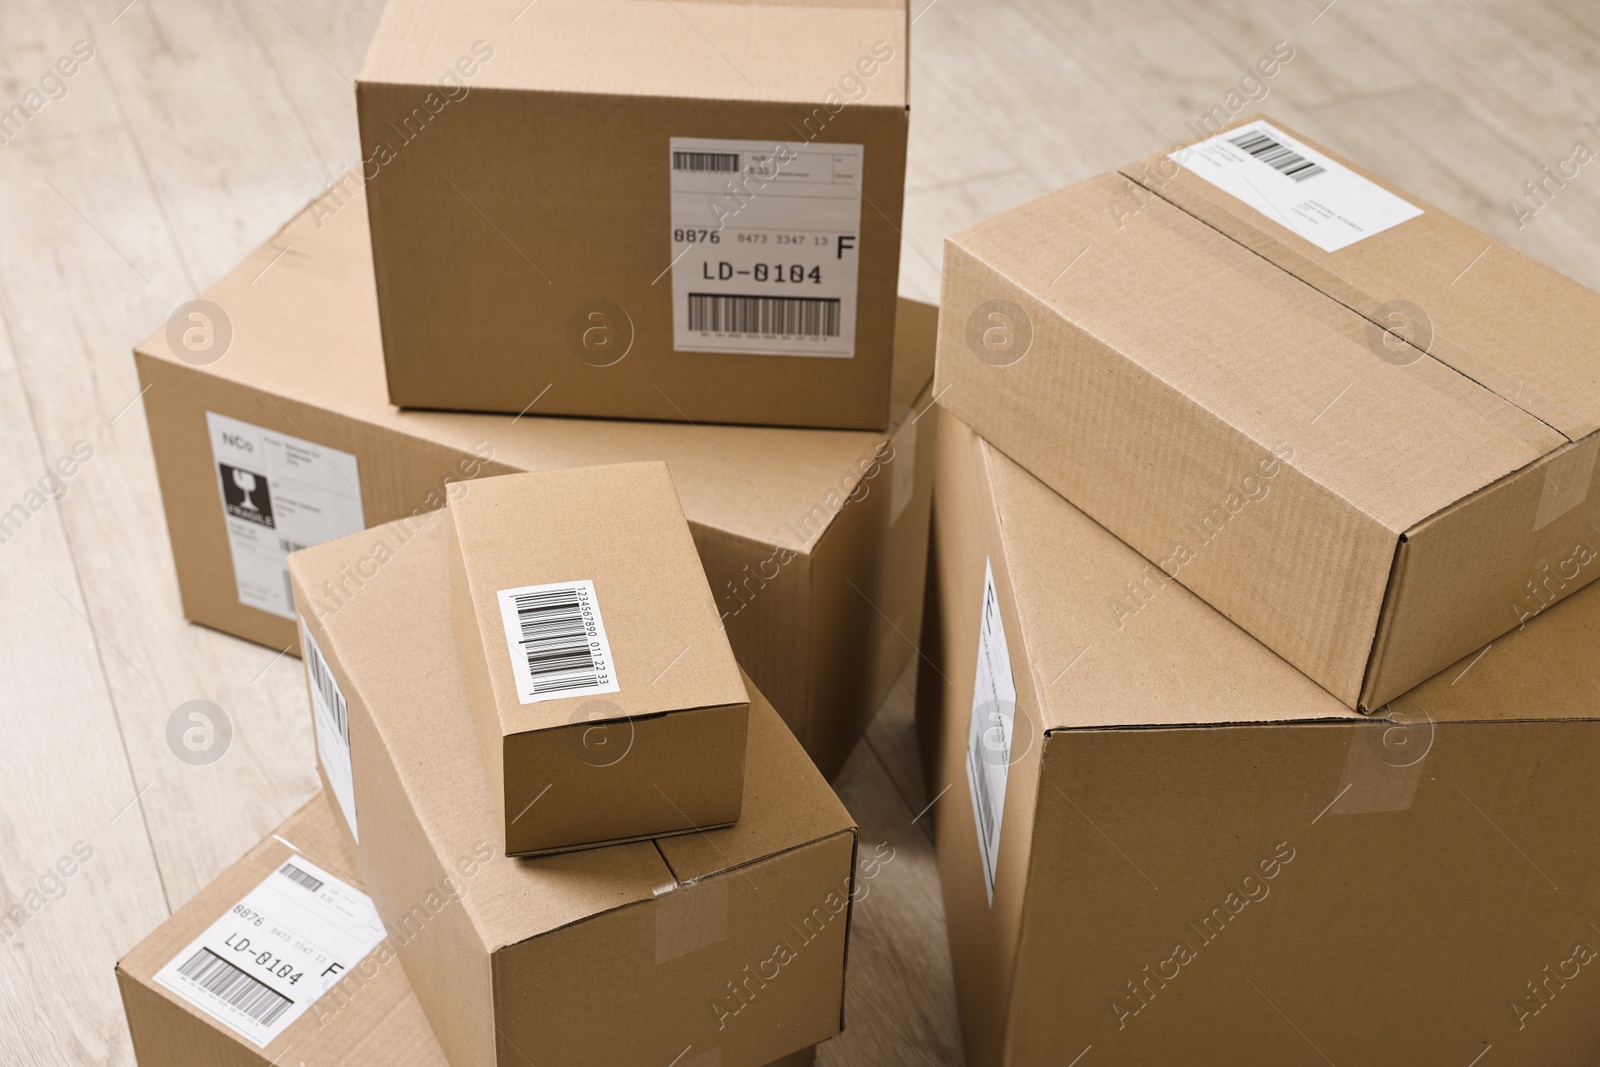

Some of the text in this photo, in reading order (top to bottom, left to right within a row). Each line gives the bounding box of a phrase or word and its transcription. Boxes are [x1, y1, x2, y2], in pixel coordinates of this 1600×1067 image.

[814, 236, 828, 247] 13
[837, 235, 856, 260] F
[703, 261, 822, 284] LD-0104
[222, 432, 254, 453] NCo
[228, 504, 274, 526] FRAGILE
[577, 587, 609, 685] 1234567890 011 22 33
[225, 932, 304, 985] LD-0104
[320, 962, 345, 977] F
